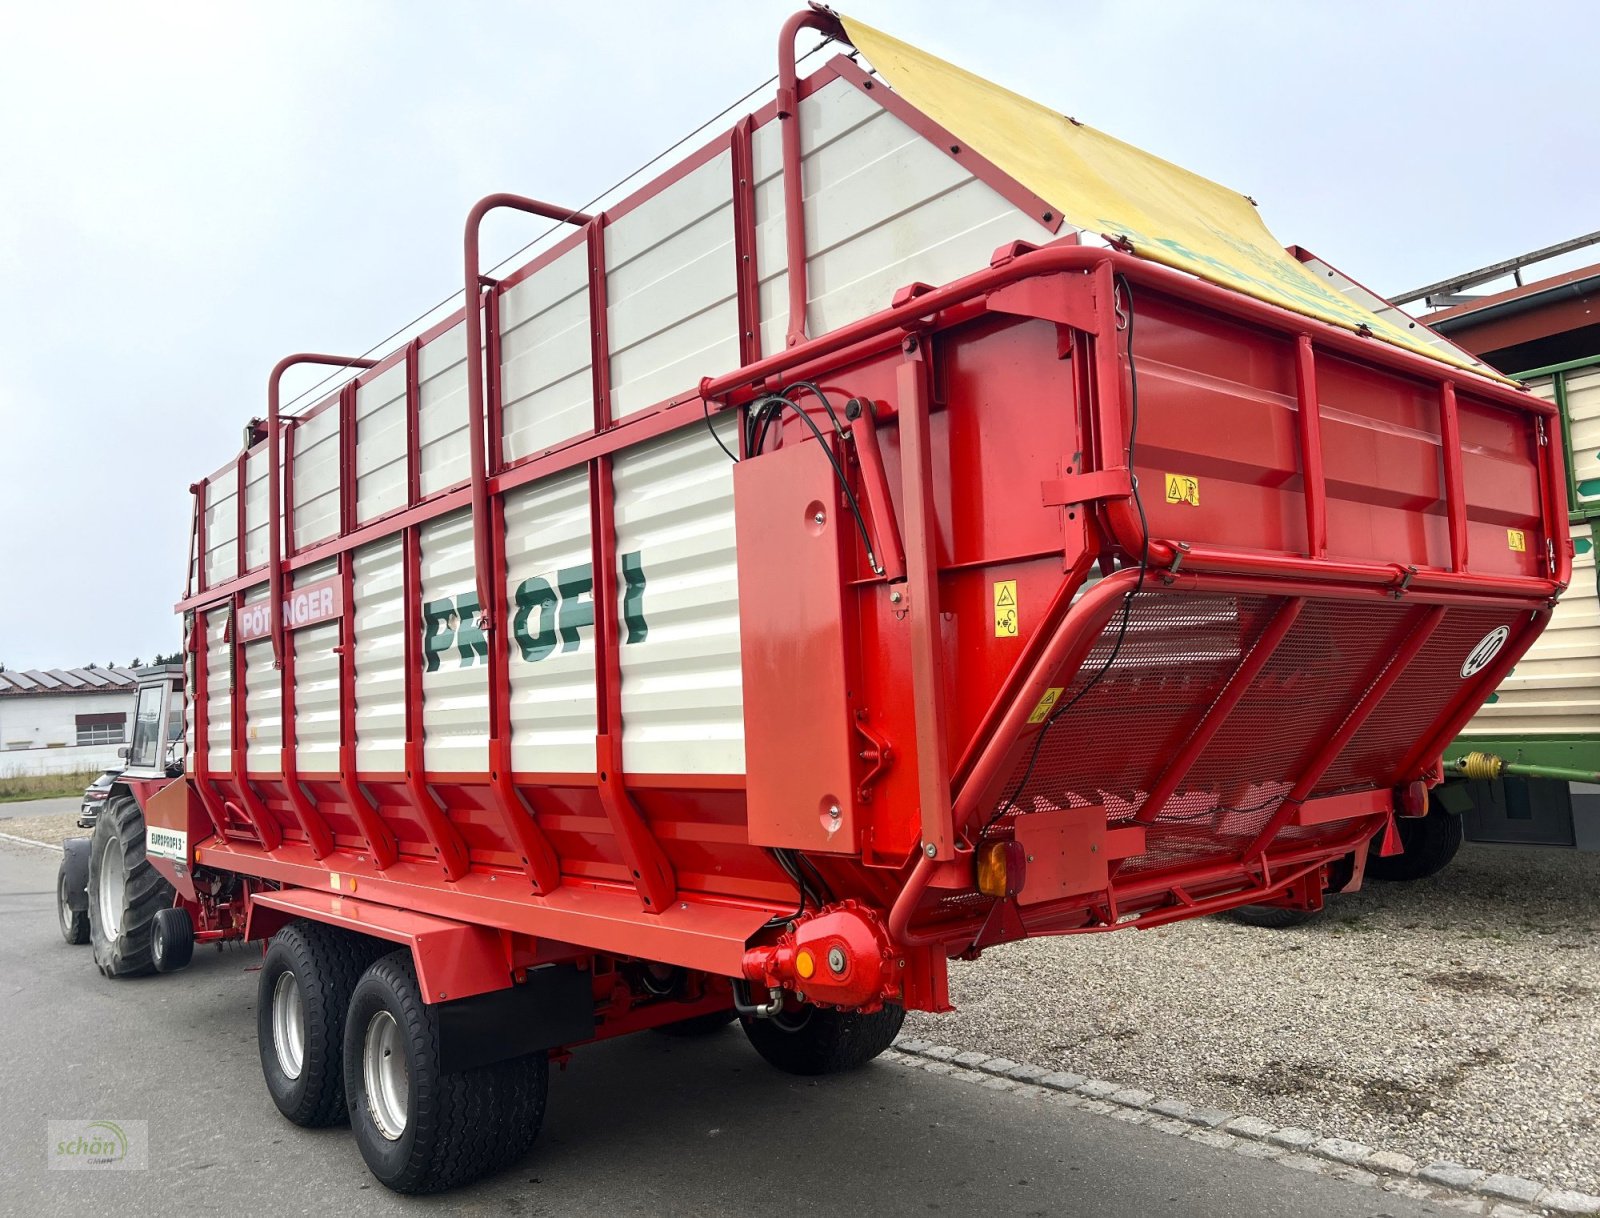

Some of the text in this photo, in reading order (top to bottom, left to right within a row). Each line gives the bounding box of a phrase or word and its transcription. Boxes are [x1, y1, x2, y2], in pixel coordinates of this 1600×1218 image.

[243, 586, 333, 638] PÖTNGER
[1467, 635, 1504, 670] 40
[151, 833, 178, 850] EUROPROFI
